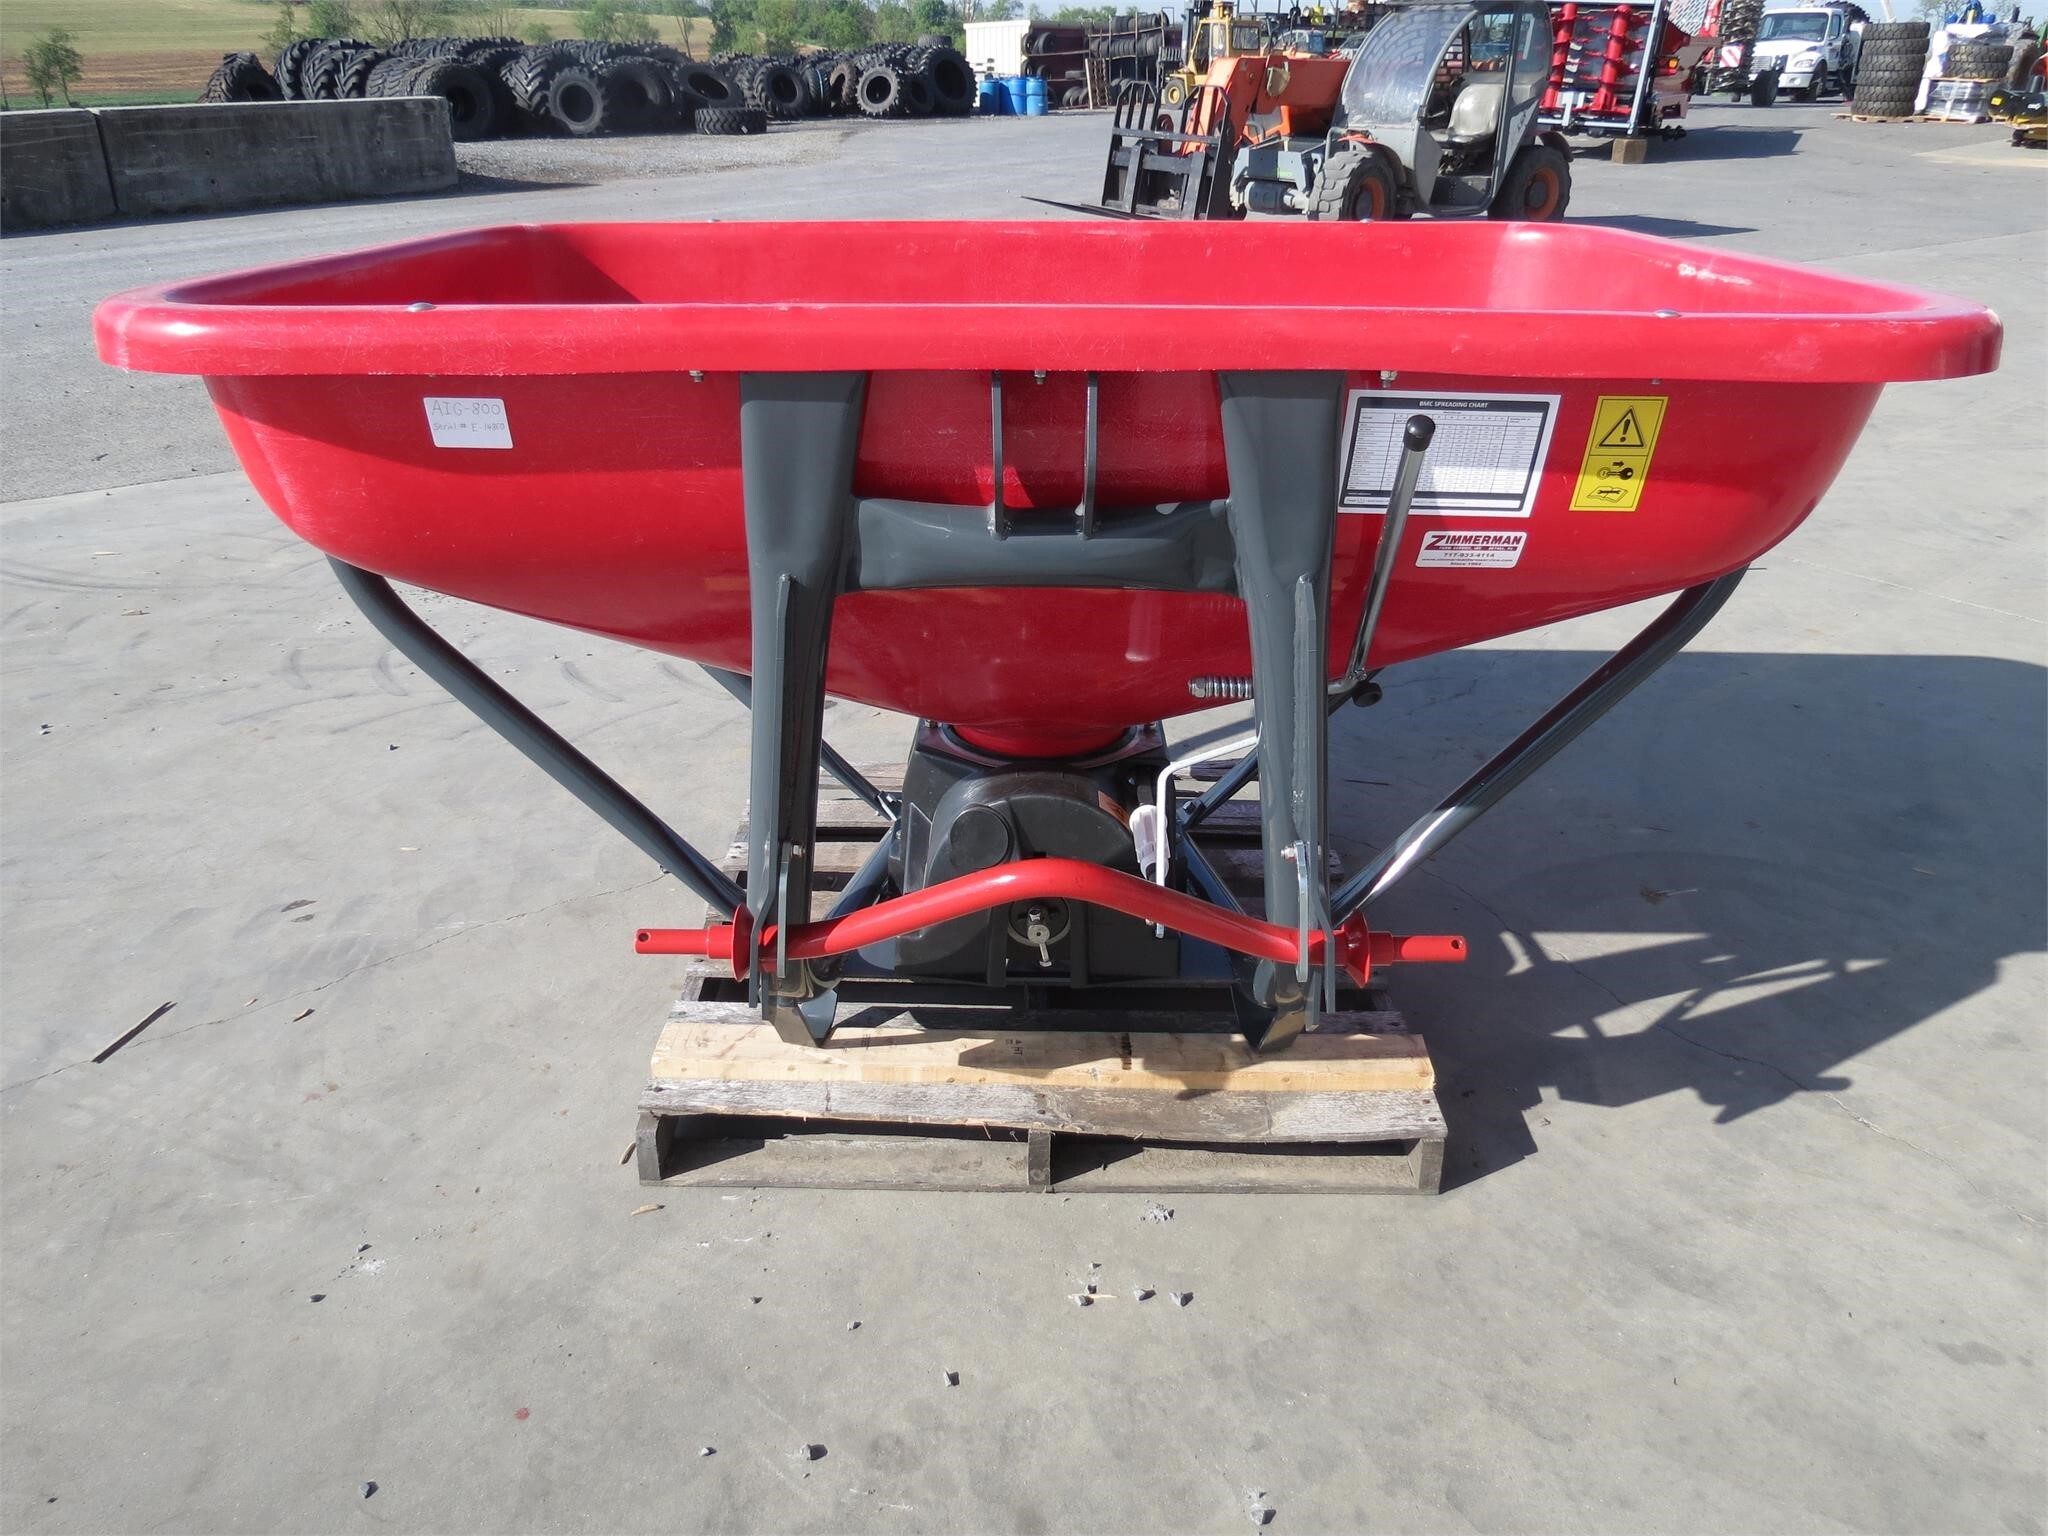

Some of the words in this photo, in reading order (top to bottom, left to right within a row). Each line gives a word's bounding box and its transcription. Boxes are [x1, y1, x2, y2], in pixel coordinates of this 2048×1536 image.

[432, 400, 501, 416] AIG-800
[1419, 400, 1434, 408] BMC
[1434, 401, 1468, 409] SPREADING
[1424, 535, 1522, 550] ZIMMERMAN
